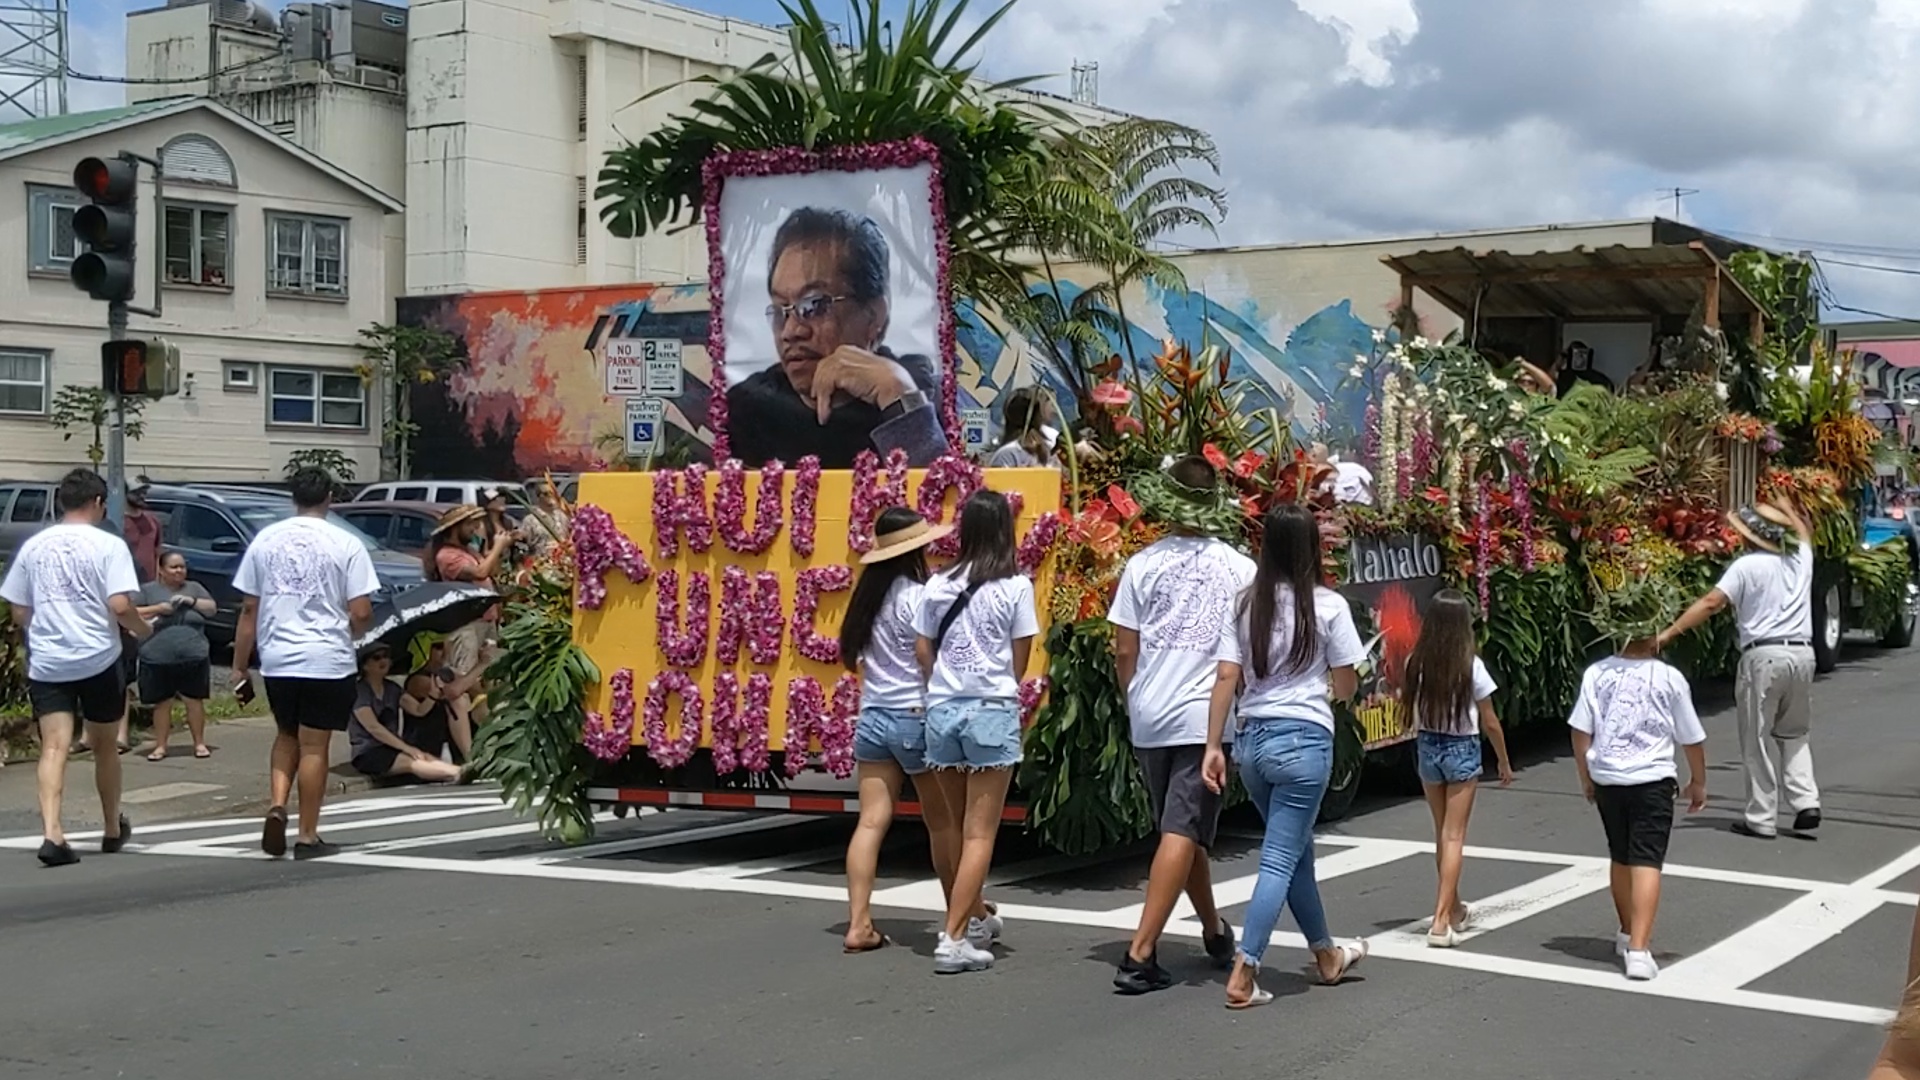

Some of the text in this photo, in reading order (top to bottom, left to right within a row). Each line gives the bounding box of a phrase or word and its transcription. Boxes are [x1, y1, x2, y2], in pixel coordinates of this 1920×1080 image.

[617, 344, 632, 355] NO
[645, 341, 655, 360] 2
[607, 356, 640, 367] PARKING
[617, 368, 632, 376] ANY
[615, 376, 634, 385] TIME
[627, 404, 661, 412] RESERVED
[651, 455, 821, 559] HUI
[655, 564, 853, 667] UNC
[584, 667, 862, 779] JOHN
